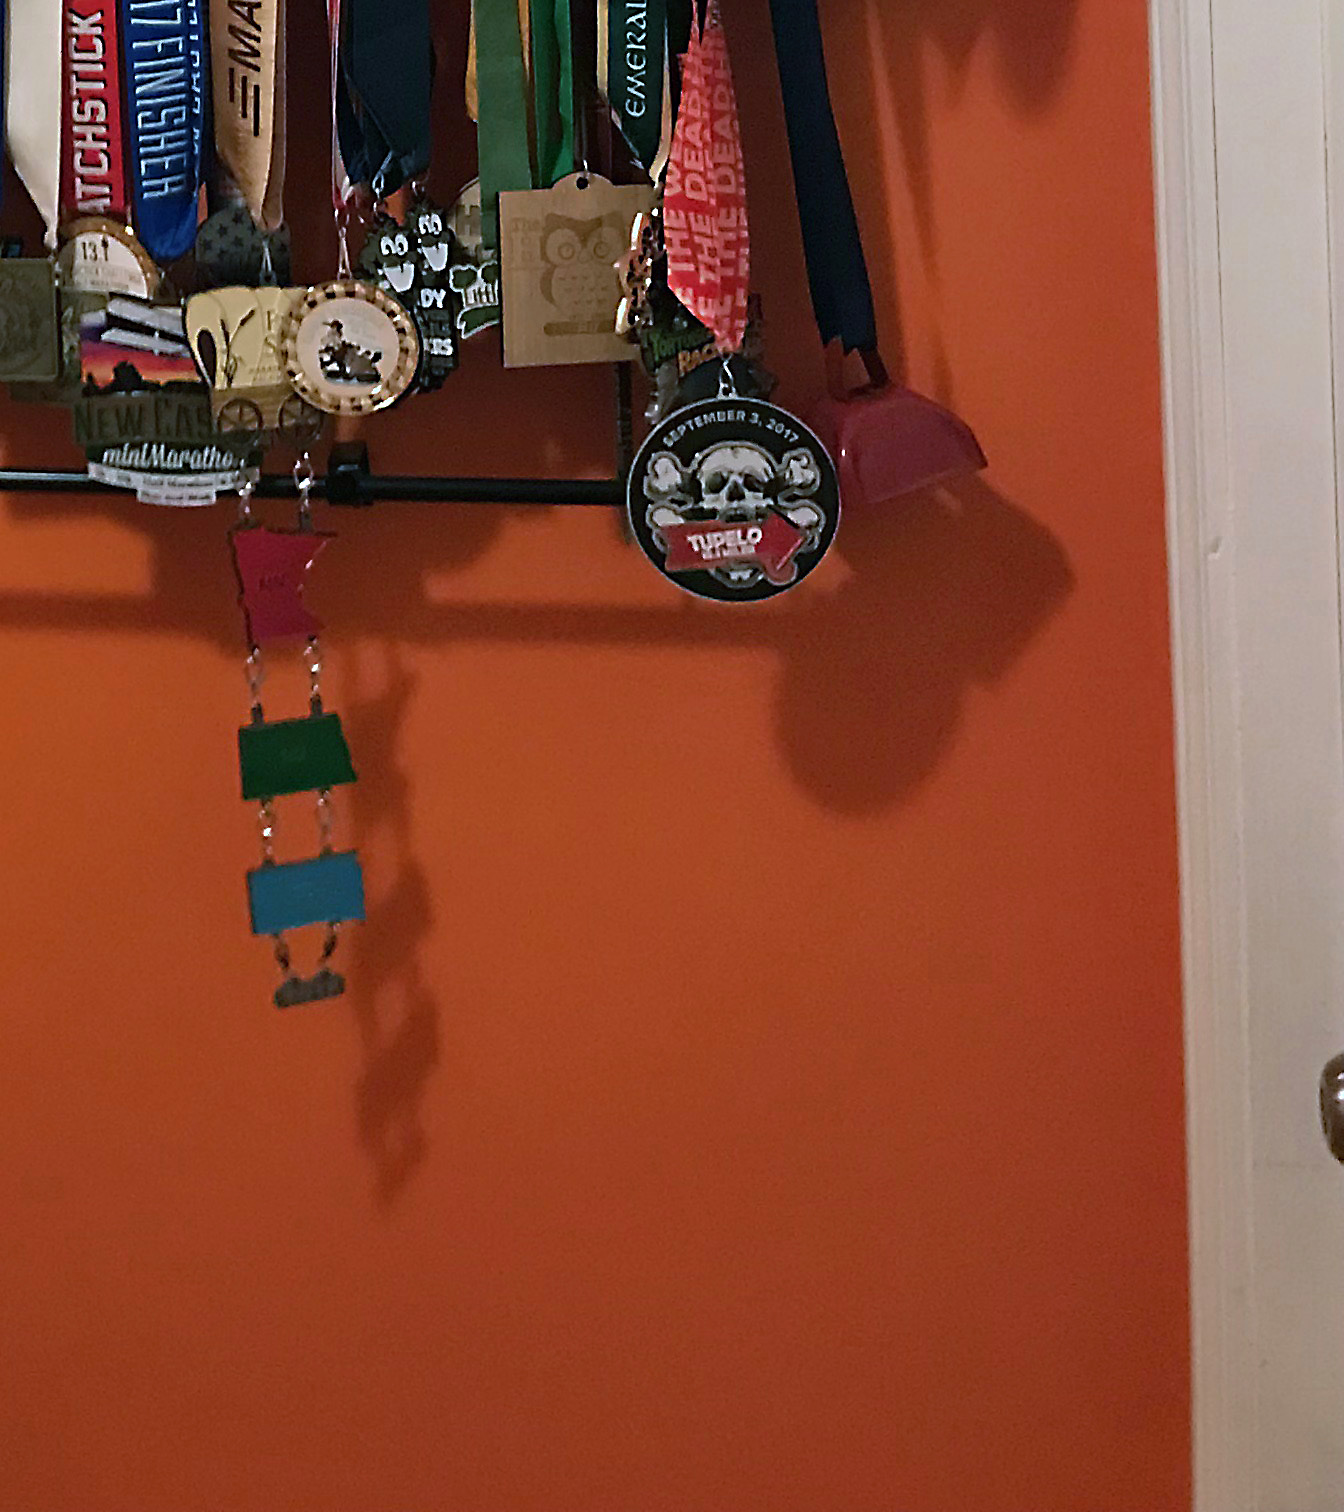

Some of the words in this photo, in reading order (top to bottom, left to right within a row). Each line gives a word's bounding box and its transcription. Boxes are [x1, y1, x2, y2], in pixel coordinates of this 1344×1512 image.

[69, 11, 106, 216] ATCHSTICK
[131, 33, 189, 202] FINISHER
[662, 409, 747, 448] SEPTEMBER
[765, 417, 799, 445] 2017
[102, 441, 240, 472] miniMaratho
[687, 525, 763, 552] TUPELO
